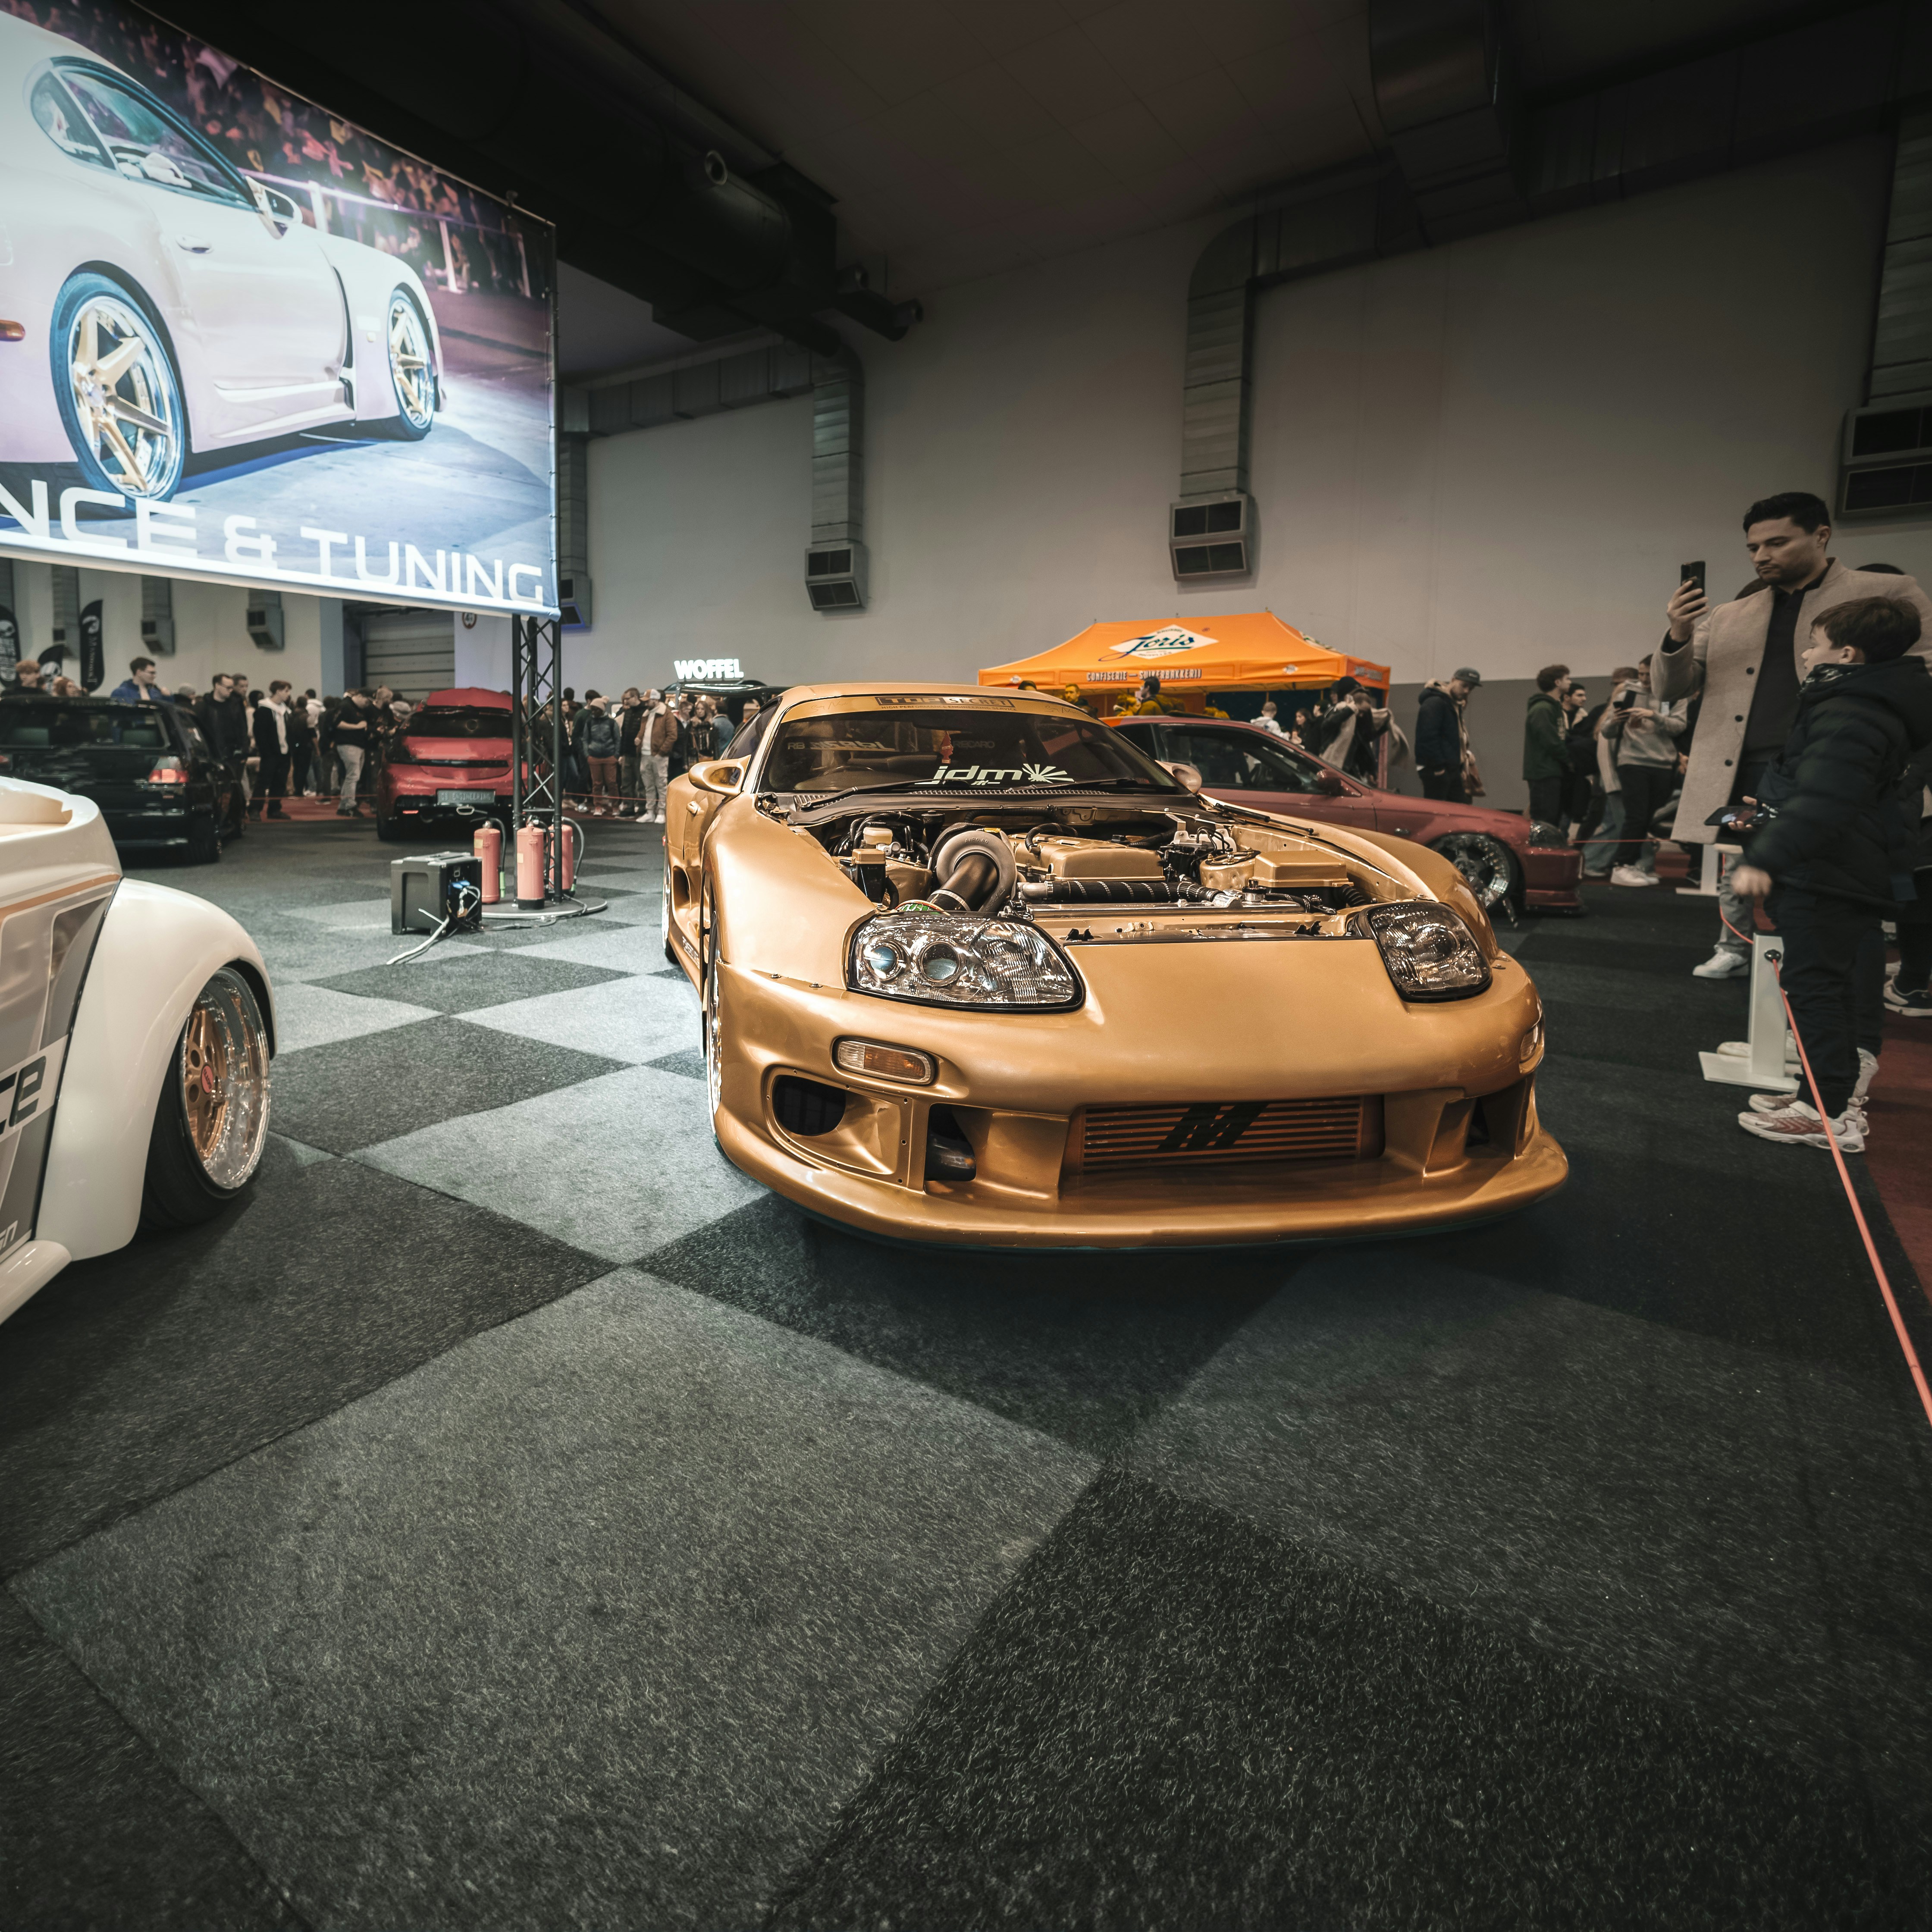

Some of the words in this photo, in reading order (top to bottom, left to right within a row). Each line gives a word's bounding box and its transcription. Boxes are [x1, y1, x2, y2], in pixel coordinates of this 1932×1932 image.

[223, 515, 277, 569] &
[300, 526, 544, 606] TUNING
[674, 659, 744, 680] WOFFEL
[1086, 671, 1127, 681] CONFISERIE
